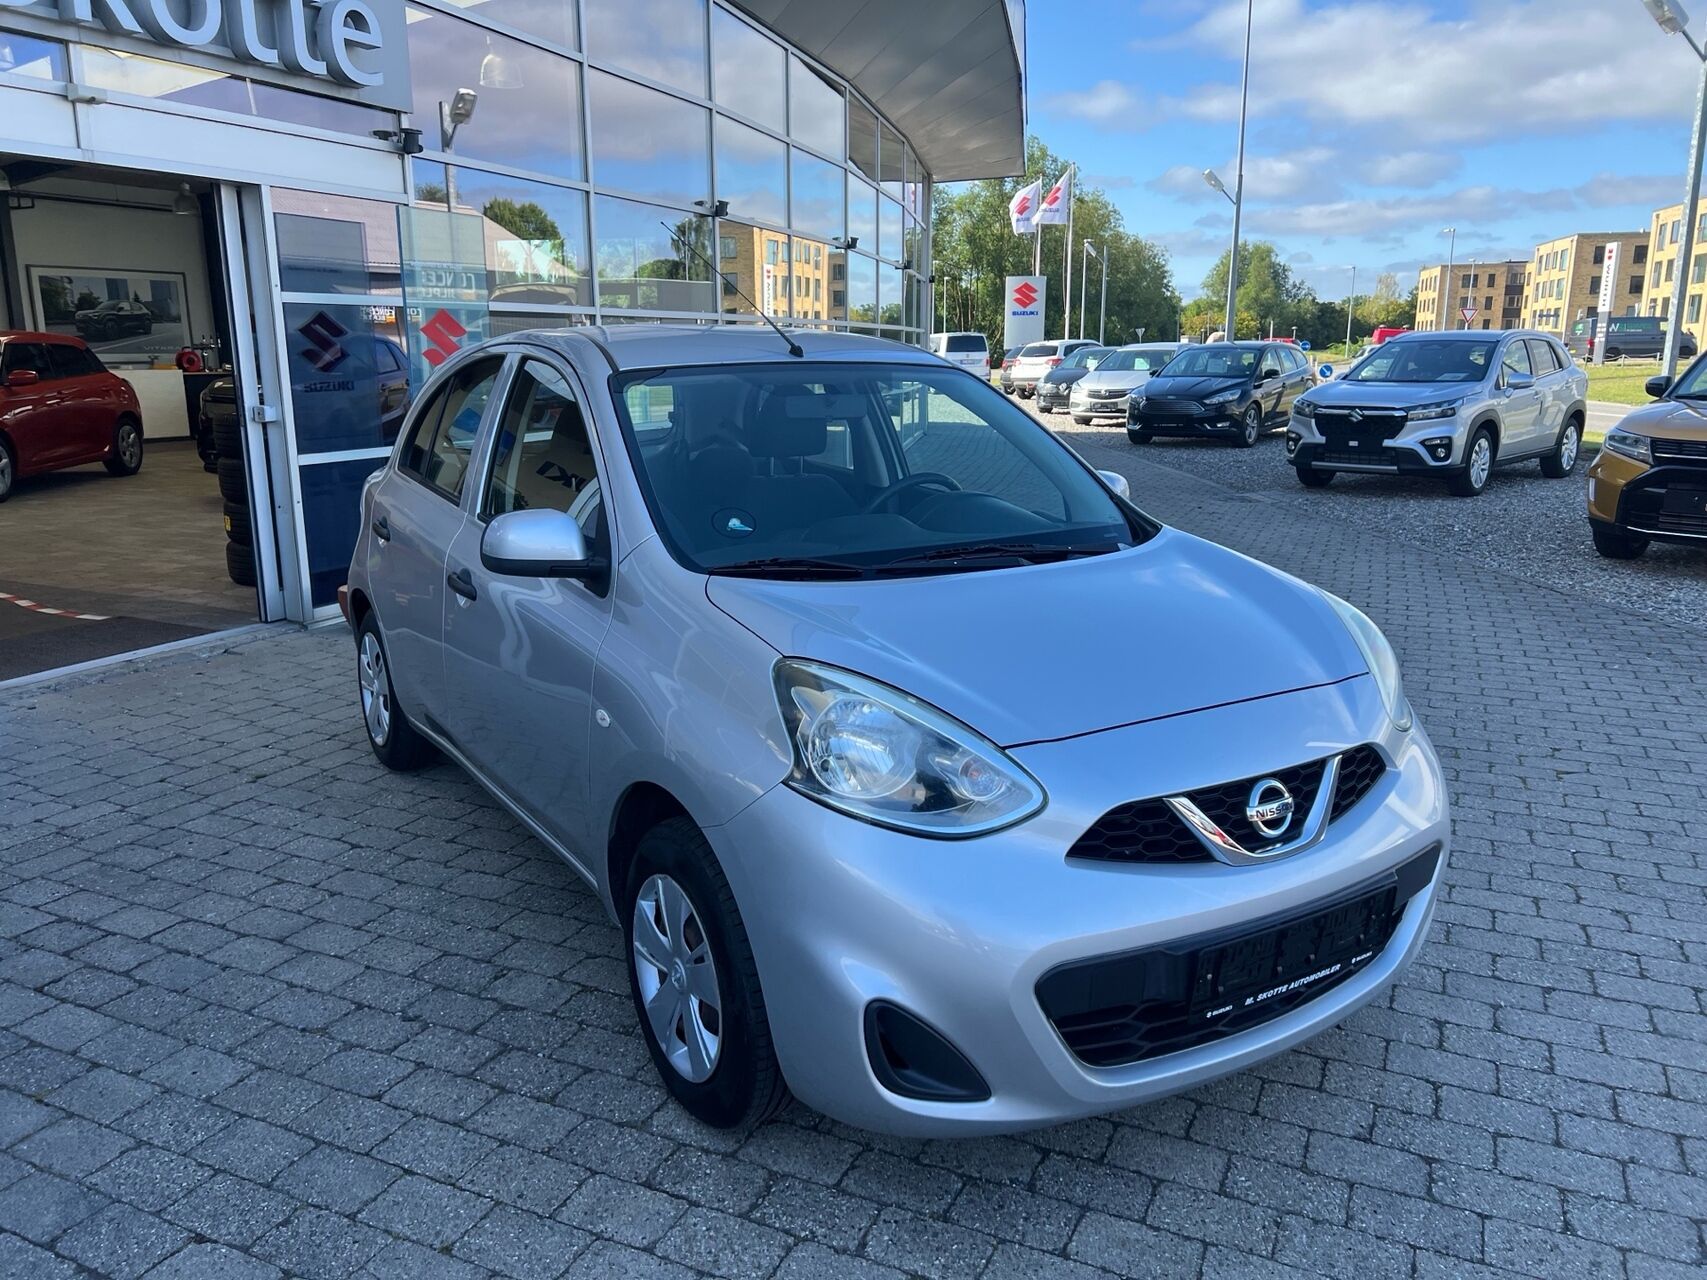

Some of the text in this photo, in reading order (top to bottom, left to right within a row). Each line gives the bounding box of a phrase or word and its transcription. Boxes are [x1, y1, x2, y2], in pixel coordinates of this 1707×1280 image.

[1244, 963, 1341, 1006] M. SKOTTE AUTOMOBILER
